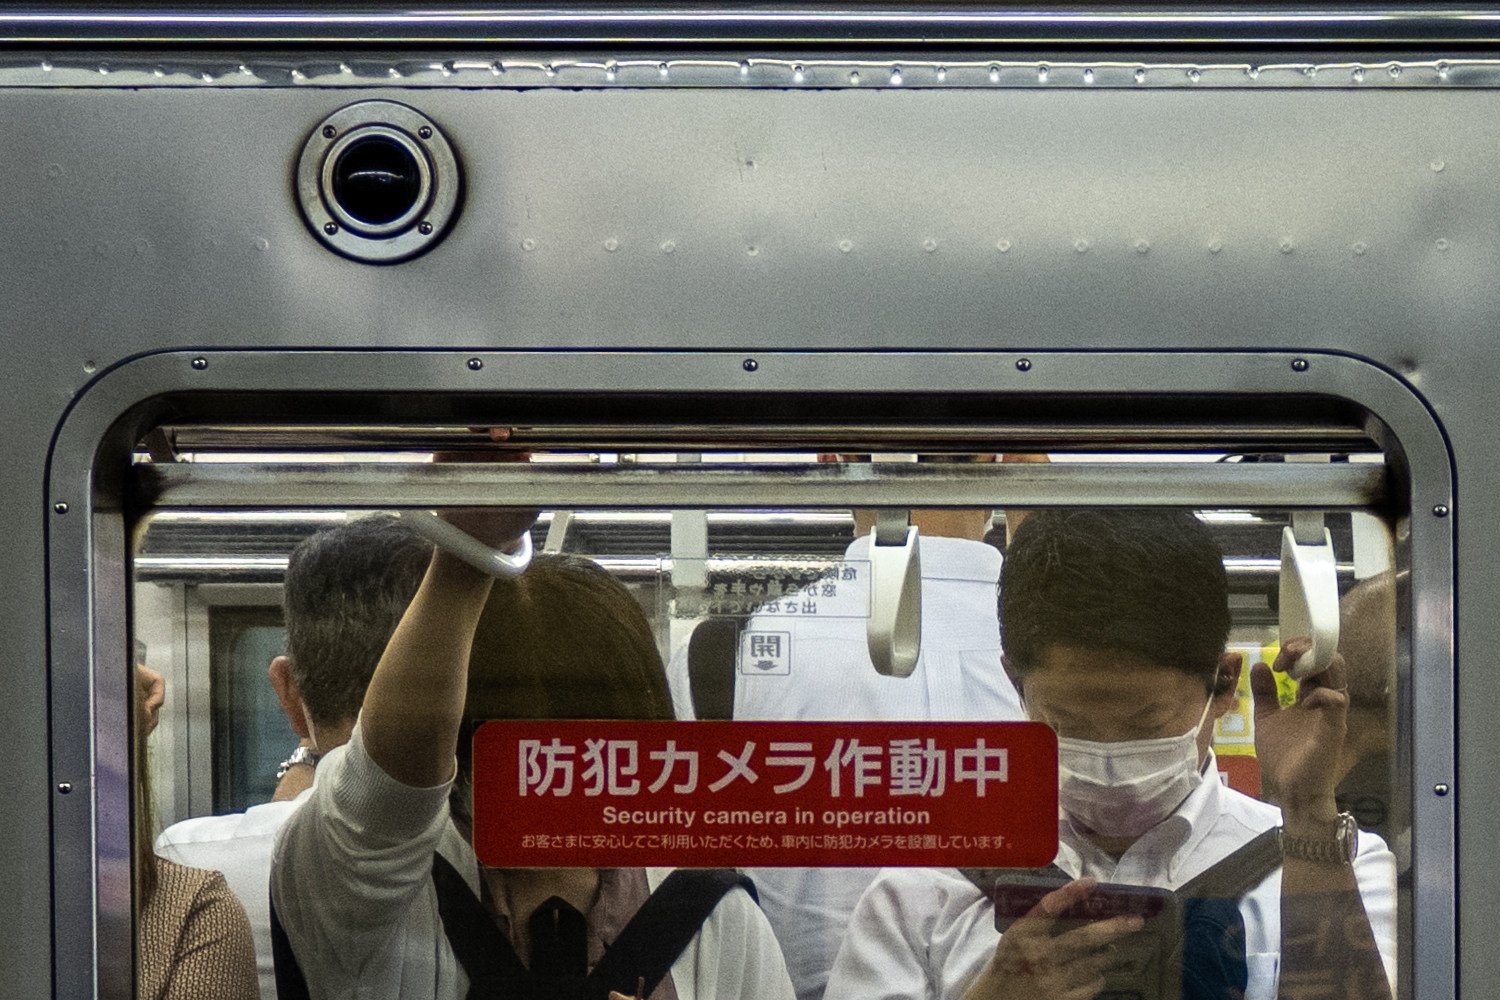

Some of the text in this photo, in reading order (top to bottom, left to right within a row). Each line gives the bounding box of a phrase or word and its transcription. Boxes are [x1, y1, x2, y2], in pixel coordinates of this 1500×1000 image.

[517, 738, 1010, 798] 防犯カメラ作動中
[602, 804, 931, 827] Security camera in operation
[521, 833, 1014, 850] お客さまに安心してご利用いただくため、車内に防犯カメラを設置しています。
